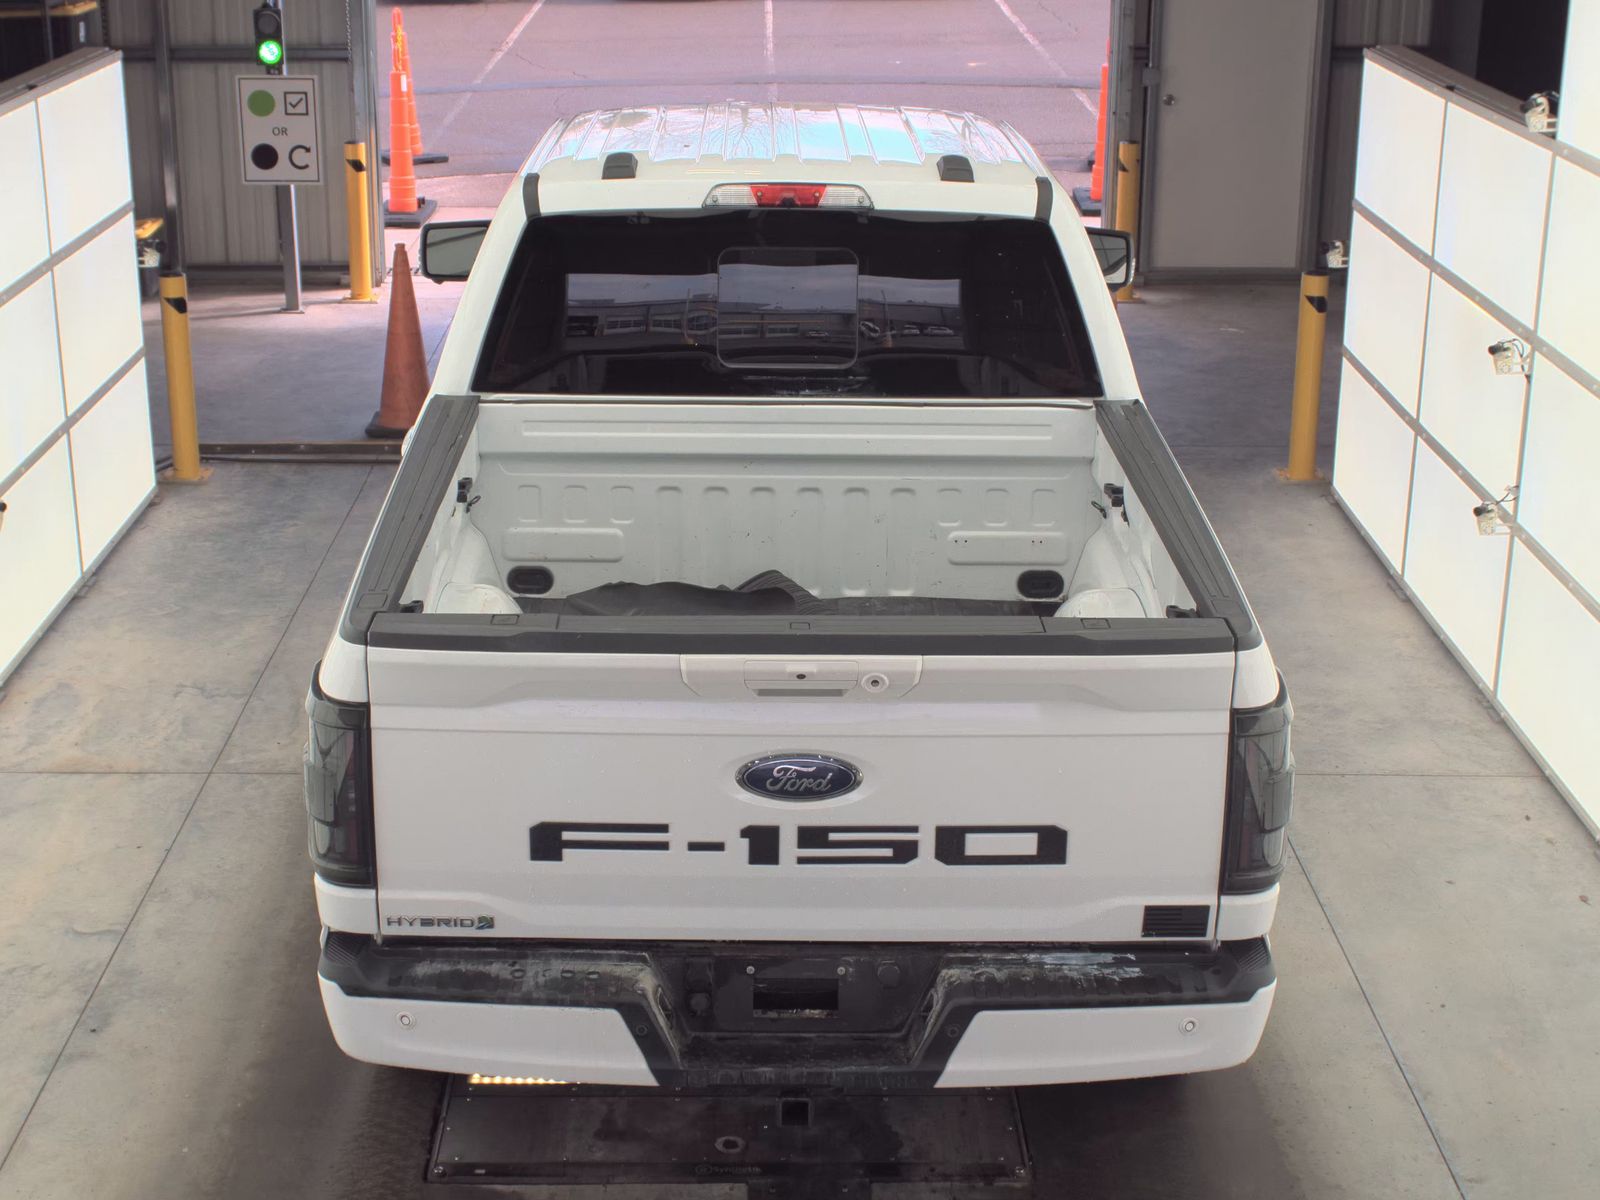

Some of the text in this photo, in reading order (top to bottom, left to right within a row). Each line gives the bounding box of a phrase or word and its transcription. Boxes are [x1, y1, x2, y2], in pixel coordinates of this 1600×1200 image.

[272, 127, 288, 136] OR
[766, 765, 832, 792] Ford
[530, 822, 1067, 865] F-150
[386, 916, 475, 928] HYBRID
